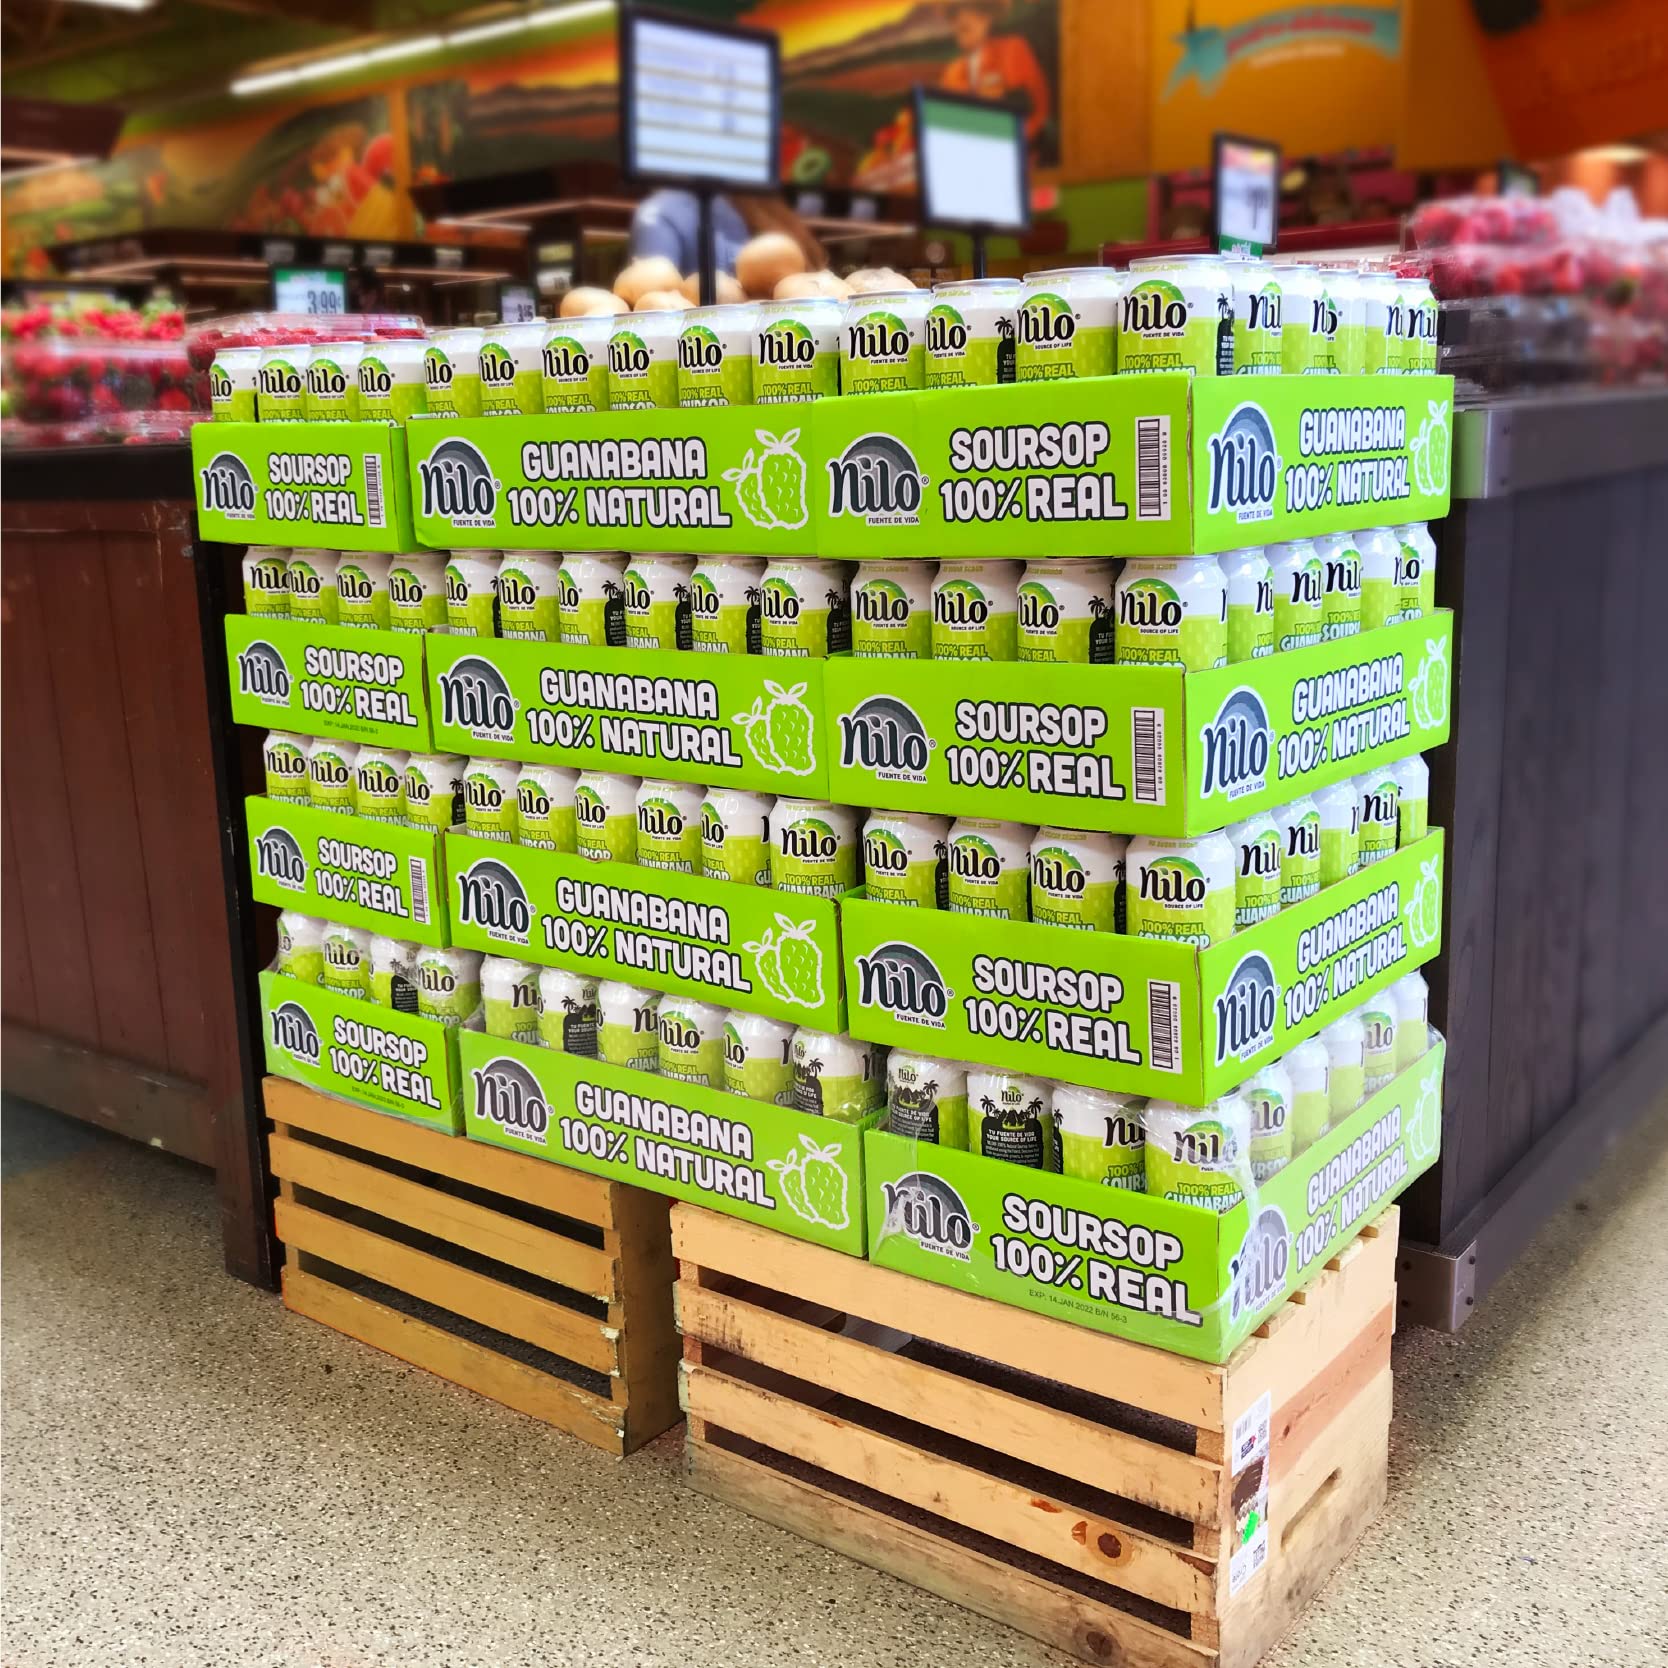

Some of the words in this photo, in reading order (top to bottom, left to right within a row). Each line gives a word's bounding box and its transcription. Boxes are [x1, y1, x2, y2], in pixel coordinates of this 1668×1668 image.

[1017, 306, 1075, 343] nilo
[1123, 293, 1187, 332] nilo
[542, 347, 589, 378] nilo
[607, 343, 649, 373] nilo
[678, 337, 721, 368] nilo
[760, 331, 814, 364] nilo
[850, 324, 909, 359] nilo
[1125, 355, 1151, 368] 100%
[1152, 354, 1182, 367] REAL
[259, 368, 300, 393] nilo
[307, 368, 345, 392] nilo
[949, 421, 1110, 471] SOURSOP
[1300, 406, 1406, 457] GUANABANA
[268, 453, 351, 485] SOURSOP
[522, 438, 706, 481] GUANABANA
[1210, 437, 1275, 509] nilo
[202, 470, 254, 509] nilo
[265, 489, 309, 519] 100%
[310, 491, 364, 525] REAL
[420, 460, 495, 515] nilo
[507, 487, 579, 527] 100%
[586, 486, 732, 528] NATURAL
[829, 459, 921, 514] nilo
[939, 477, 1022, 523] 100%
[1026, 472, 1128, 521] REAL
[1285, 464, 1332, 512] 100%
[1337, 456, 1410, 506] NATURAL
[856, 591, 909, 621] nilo
[934, 591, 988, 625] nilo
[1120, 590, 1182, 626] nilo
[239, 654, 289, 697] nilo
[305, 644, 403, 687] SOURSOP
[1120, 648, 1147, 661] 100%
[1149, 648, 1179, 662] REAL
[300, 681, 351, 714] 100%
[354, 687, 418, 727] REAL
[440, 675, 514, 730] nilo
[540, 667, 719, 720] GUANABANA
[1293, 652, 1403, 725] GUANABANA
[526, 708, 595, 749] 100%
[601, 717, 743, 768] NATURAL
[840, 716, 928, 771] nilo
[955, 699, 1108, 748] SOURSOP
[1277, 724, 1327, 780] 100%
[1331, 698, 1410, 762] NATURAL
[267, 751, 305, 774] nilo
[310, 759, 348, 783] nilo
[359, 767, 399, 792] nilo
[913, 774, 927, 782] VIDA
[945, 745, 1024, 787] 100%
[1027, 750, 1126, 803] REAL
[1204, 719, 1268, 794] nilo
[638, 805, 683, 835] nilo
[782, 828, 837, 858] nilo
[257, 838, 305, 882] nilo
[318, 836, 397, 880] SOURSOP
[950, 843, 1000, 878] nilo
[1033, 855, 1085, 892] nilo
[314, 869, 356, 902] 100%
[357, 877, 409, 918] REAL
[459, 875, 529, 934] nilo
[1140, 866, 1205, 902] nilo
[556, 877, 729, 944] GUANABANA
[1143, 920, 1174, 934] 100%
[1176, 922, 1204, 935] REAL
[1297, 881, 1399, 974] GUANABANA
[542, 915, 609, 959] 100%
[615, 929, 752, 994] NATURAL
[1284, 967, 1329, 1030] 100%
[1332, 924, 1407, 1005] NATURAL
[858, 959, 947, 1017] nilo
[972, 954, 1123, 1014] SOURSOP
[270, 1011, 319, 1058] nilo
[333, 1014, 427, 1069] SOURSOP
[659, 1018, 700, 1048] nilo
[897, 1014, 920, 1024] FUENTE
[931, 1020, 945, 1028] VIDA
[963, 996, 1043, 1043] 100%
[1045, 1008, 1142, 1065] REAL
[1217, 981, 1274, 1061] nilo
[329, 1046, 379, 1085] 100%
[380, 1062, 441, 1110] REAL
[473, 1071, 547, 1133] nilo
[575, 1080, 753, 1162] GUANABANA
[559, 1117, 629, 1164] 100%
[635, 1137, 776, 1210] NATURAL
[1306, 1104, 1402, 1217] GUANABANA
[1295, 1203, 1337, 1273] 100%
[1340, 1142, 1409, 1232] NATURAL
[1002, 1192, 1184, 1271] SOURSOP
[990, 1234, 1084, 1290] 100%
[1088, 1259, 1203, 1327] REAL
